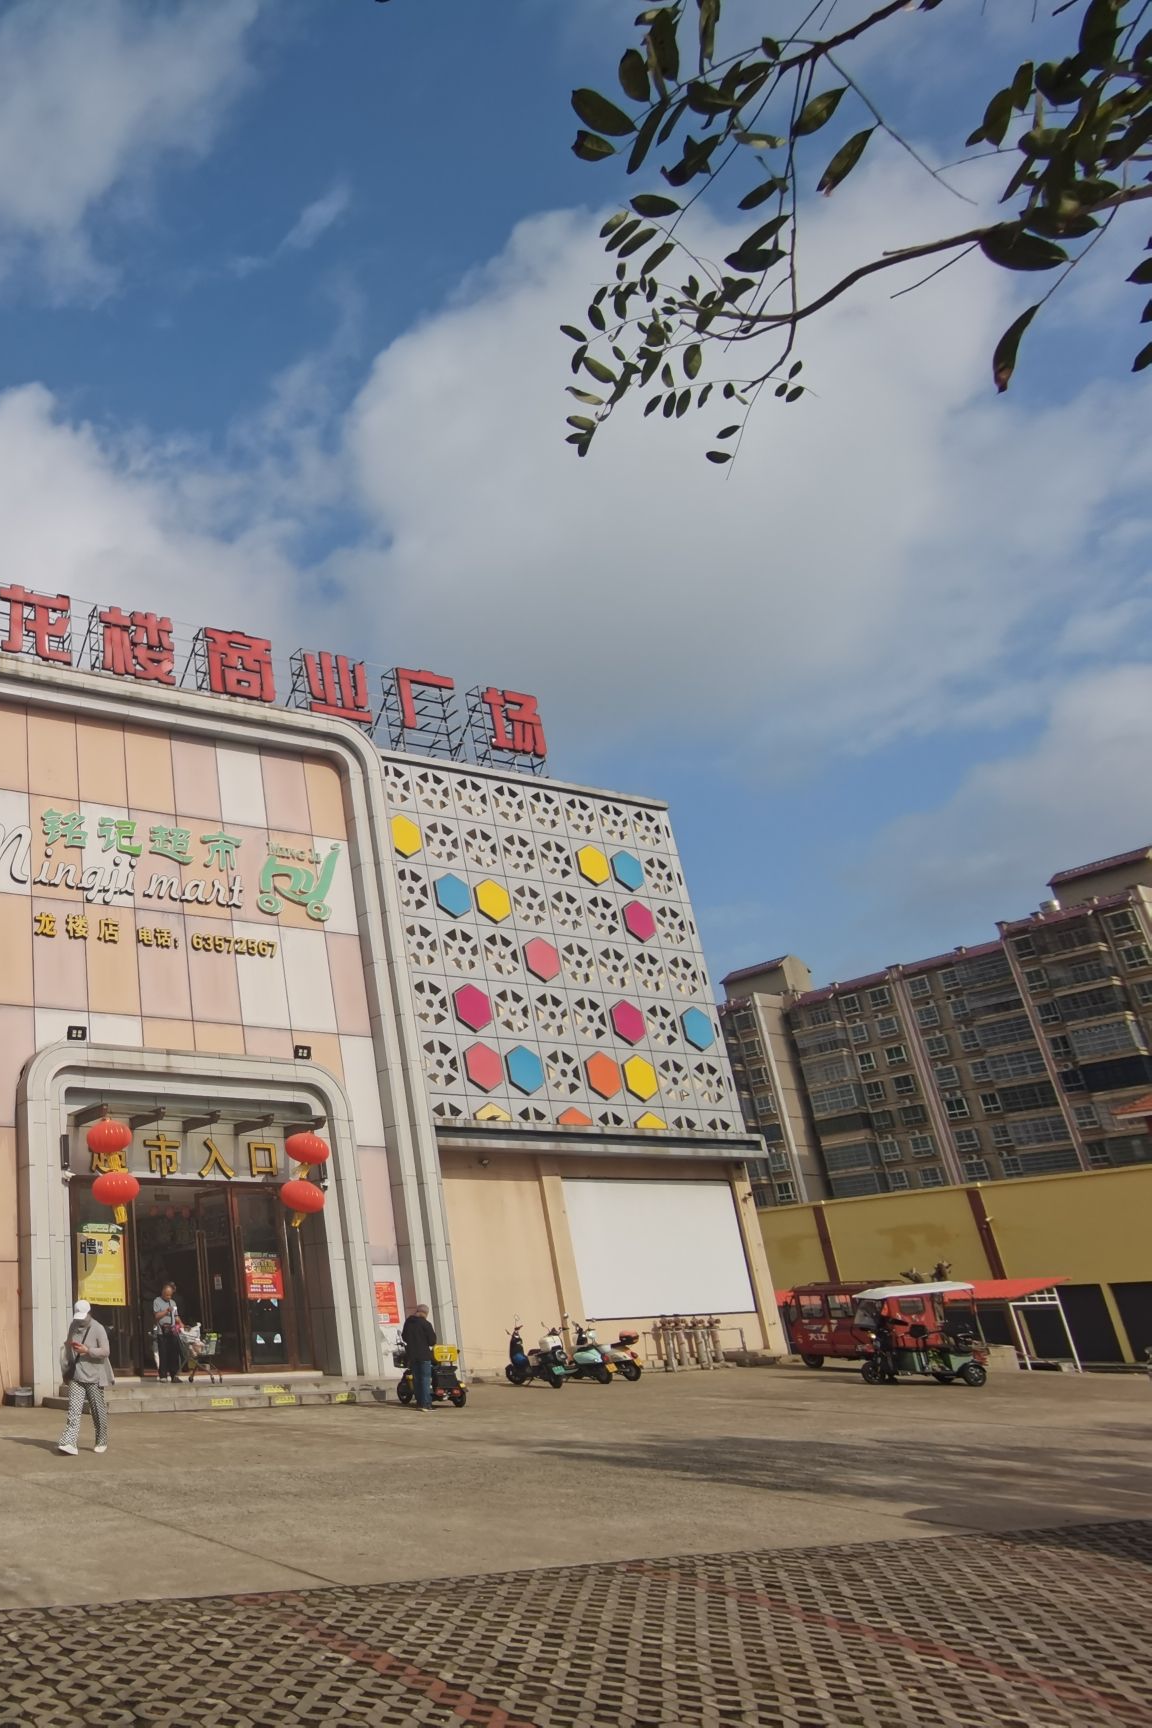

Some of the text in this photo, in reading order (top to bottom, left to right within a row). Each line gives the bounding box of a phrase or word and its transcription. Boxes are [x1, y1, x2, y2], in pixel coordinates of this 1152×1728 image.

[41, 808, 244, 872] 铭记超市
[143, 873, 244, 908] mart
[35, 912, 120, 944] 龙楼店
[191, 933, 279, 958] 63572567
